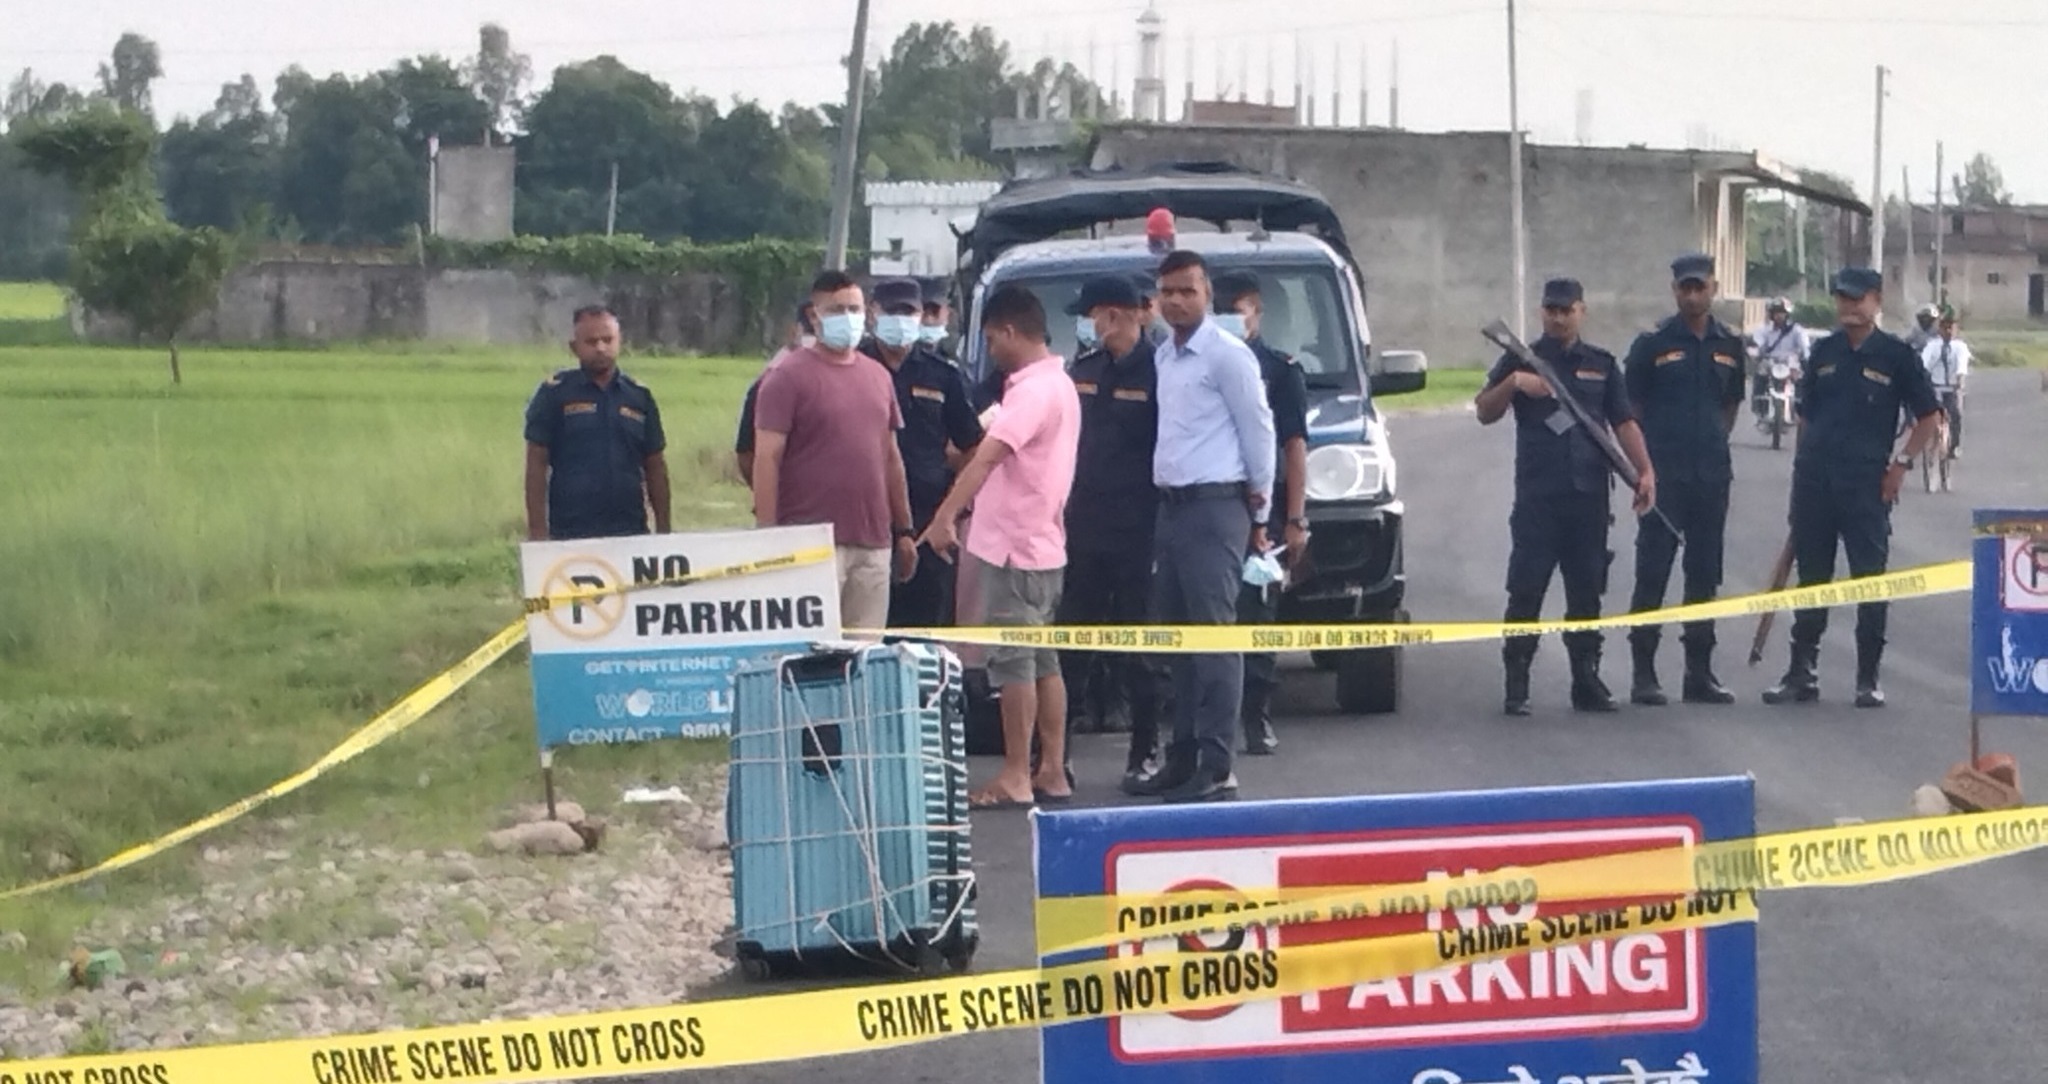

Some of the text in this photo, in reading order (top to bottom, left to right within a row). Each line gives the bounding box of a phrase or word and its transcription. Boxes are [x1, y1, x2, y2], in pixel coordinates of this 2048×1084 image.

[632, 555, 691, 587] NO
[635, 596, 825, 637] PARKING
[585, 656, 731, 675] GET INTERNET
[1438, 922, 1530, 960] CRIME
[1540, 908, 1630, 943] SCENE
[857, 950, 1279, 1041] CRIME SCENE DO NOT CROSS
[311, 1016, 705, 1084] CRIME SCENE DO NOT CROSS
